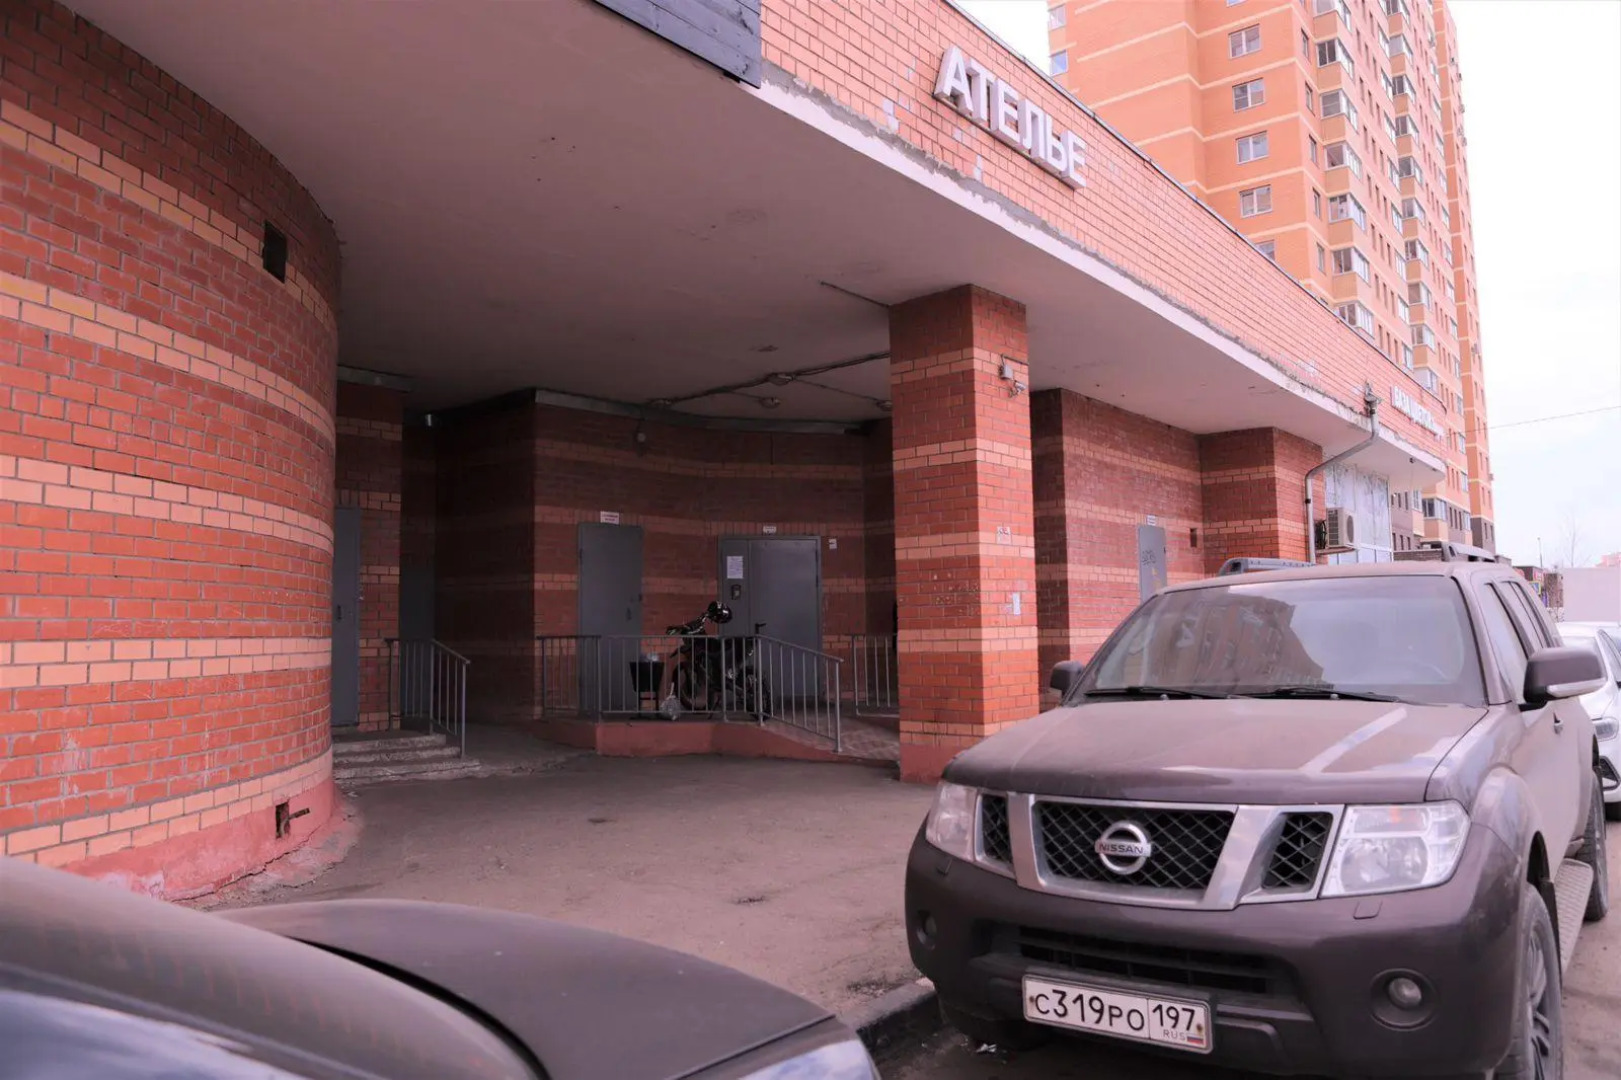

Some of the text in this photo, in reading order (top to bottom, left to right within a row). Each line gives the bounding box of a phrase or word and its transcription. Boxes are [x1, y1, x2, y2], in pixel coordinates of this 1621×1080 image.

[935, 46, 1087, 187] АТЕЛЬЕ
[1098, 843, 1144, 854] NISSAN
[1152, 1004, 1195, 1031] 197
[1163, 1029, 1186, 1041] RUS
